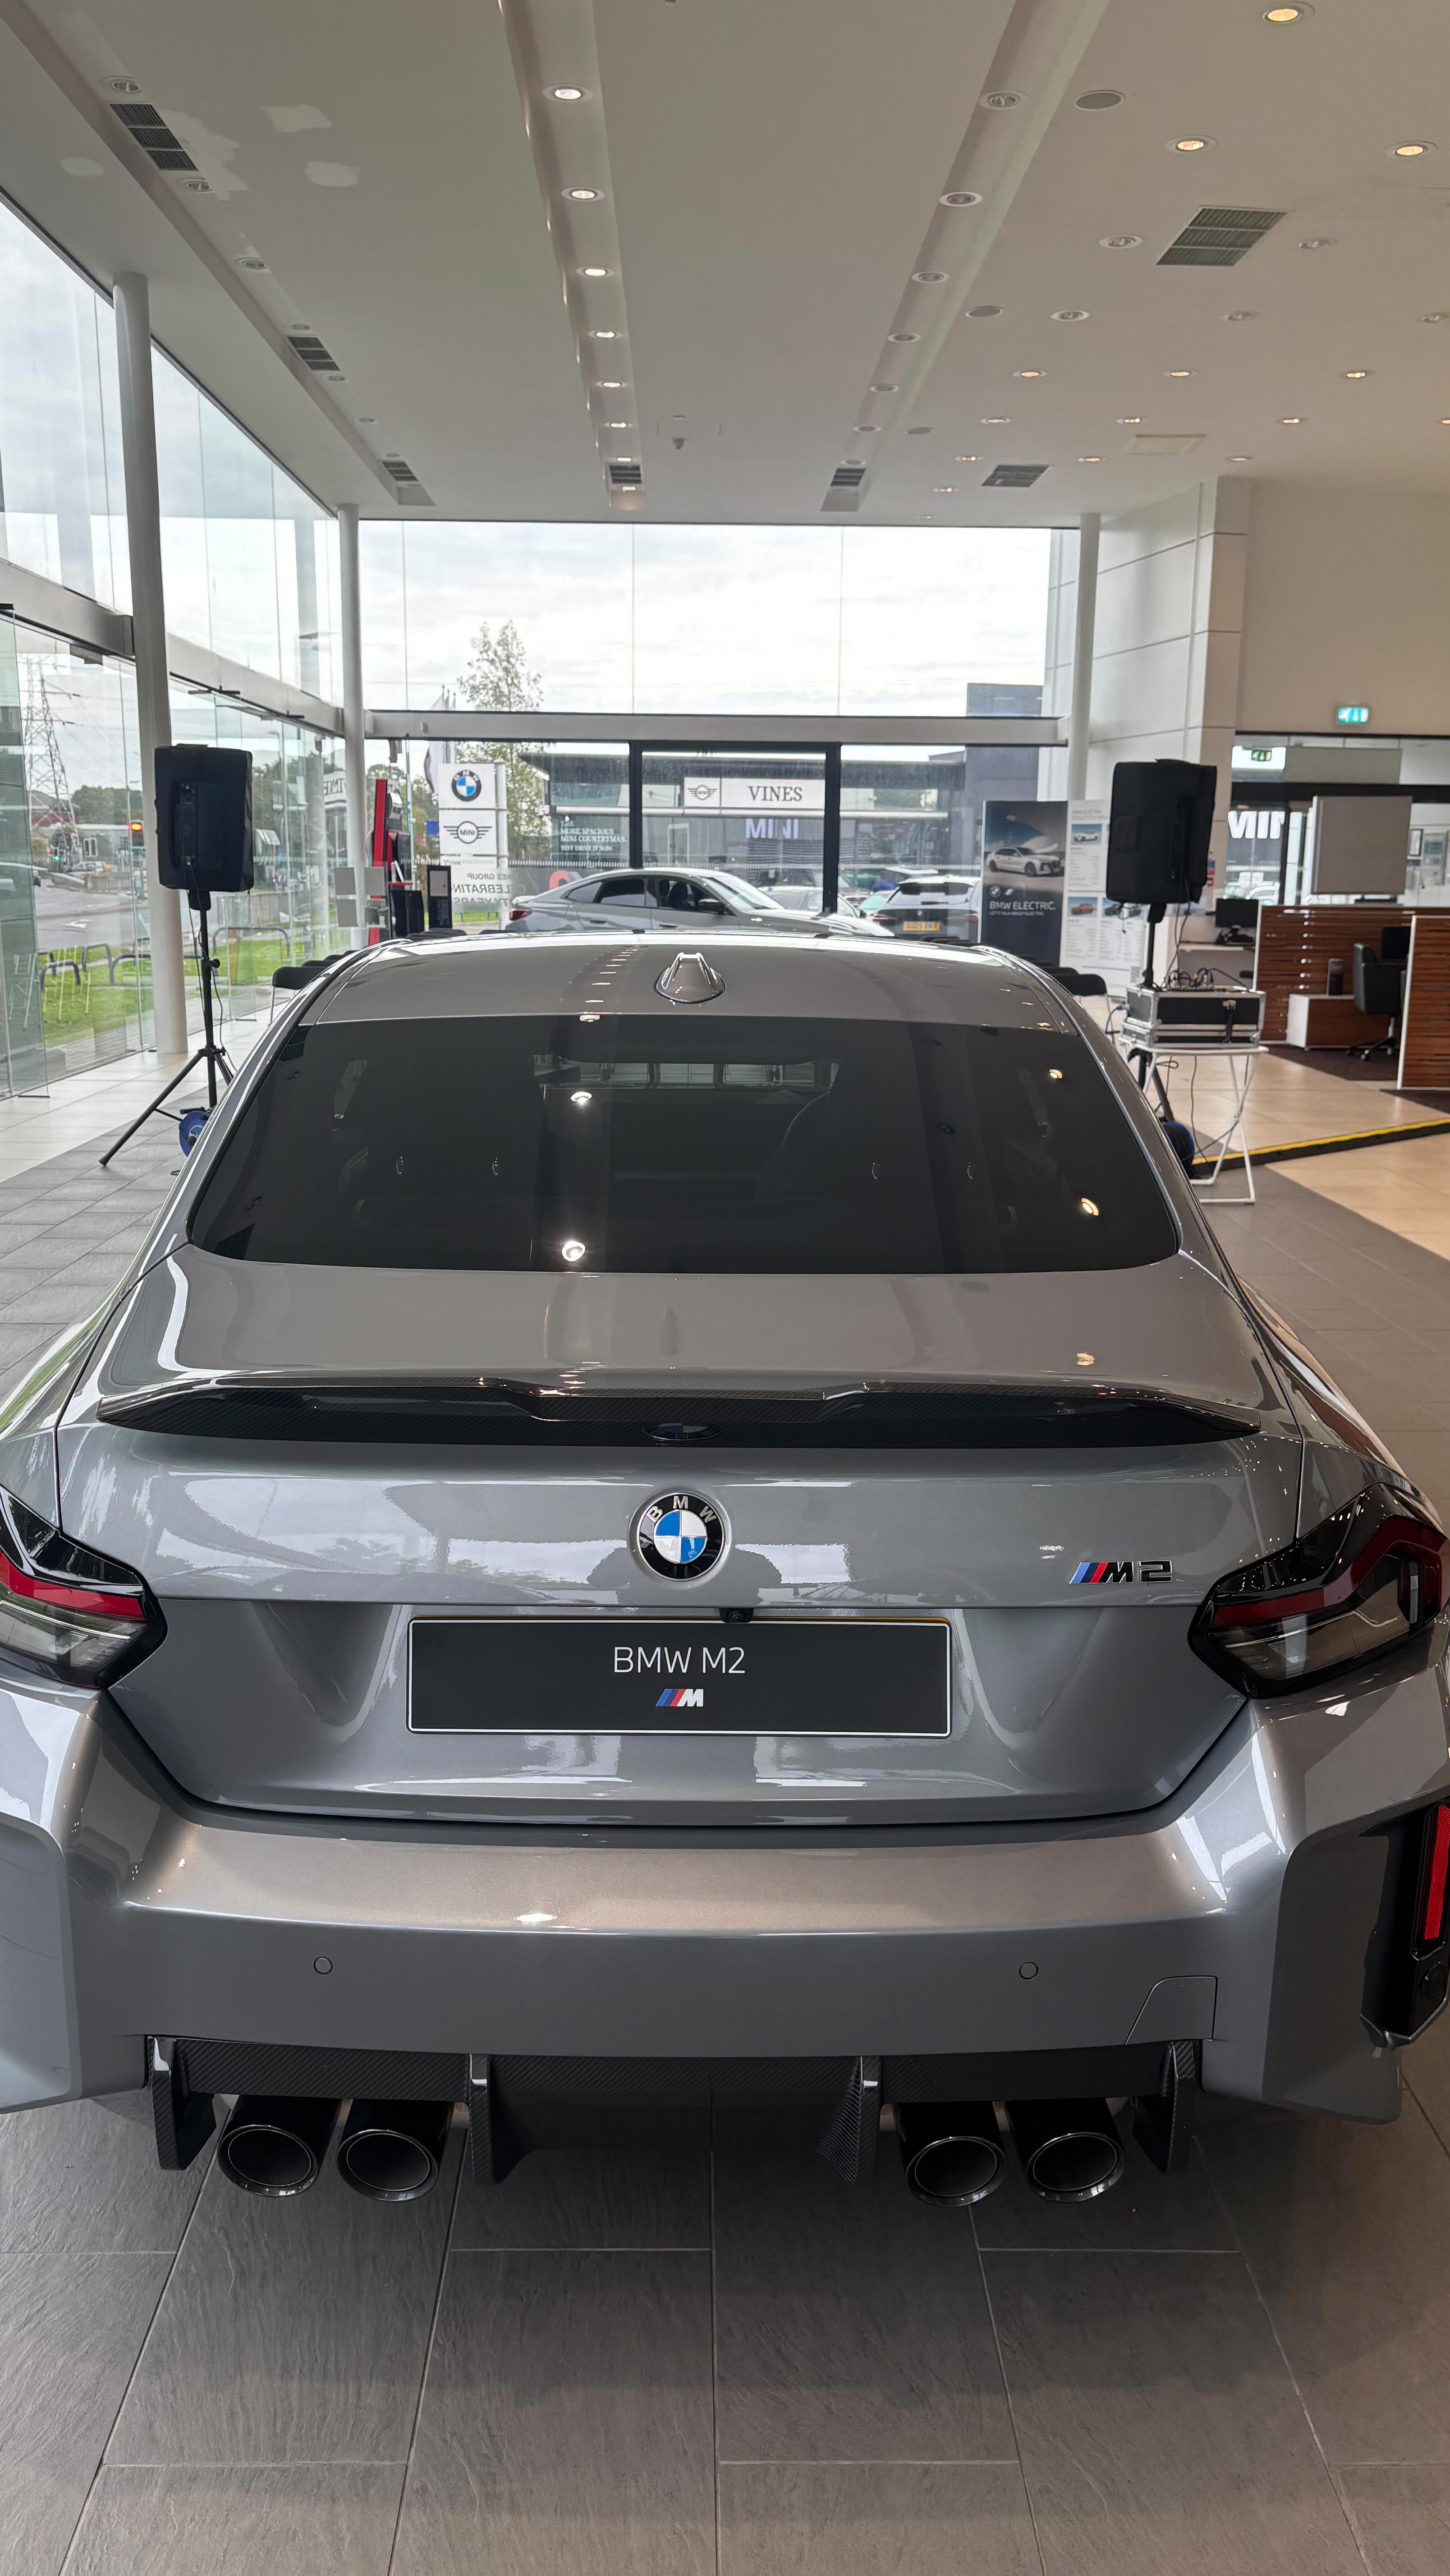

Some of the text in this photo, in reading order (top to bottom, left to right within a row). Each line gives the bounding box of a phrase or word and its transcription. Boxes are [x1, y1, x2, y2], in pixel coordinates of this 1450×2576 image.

[748, 786, 802, 801] VINES
[989, 901, 1011, 910] BMW
[646, 1496, 716, 1523] BMW
[1097, 1560, 1172, 1583] M2
[614, 1647, 745, 1674] BMW M2
